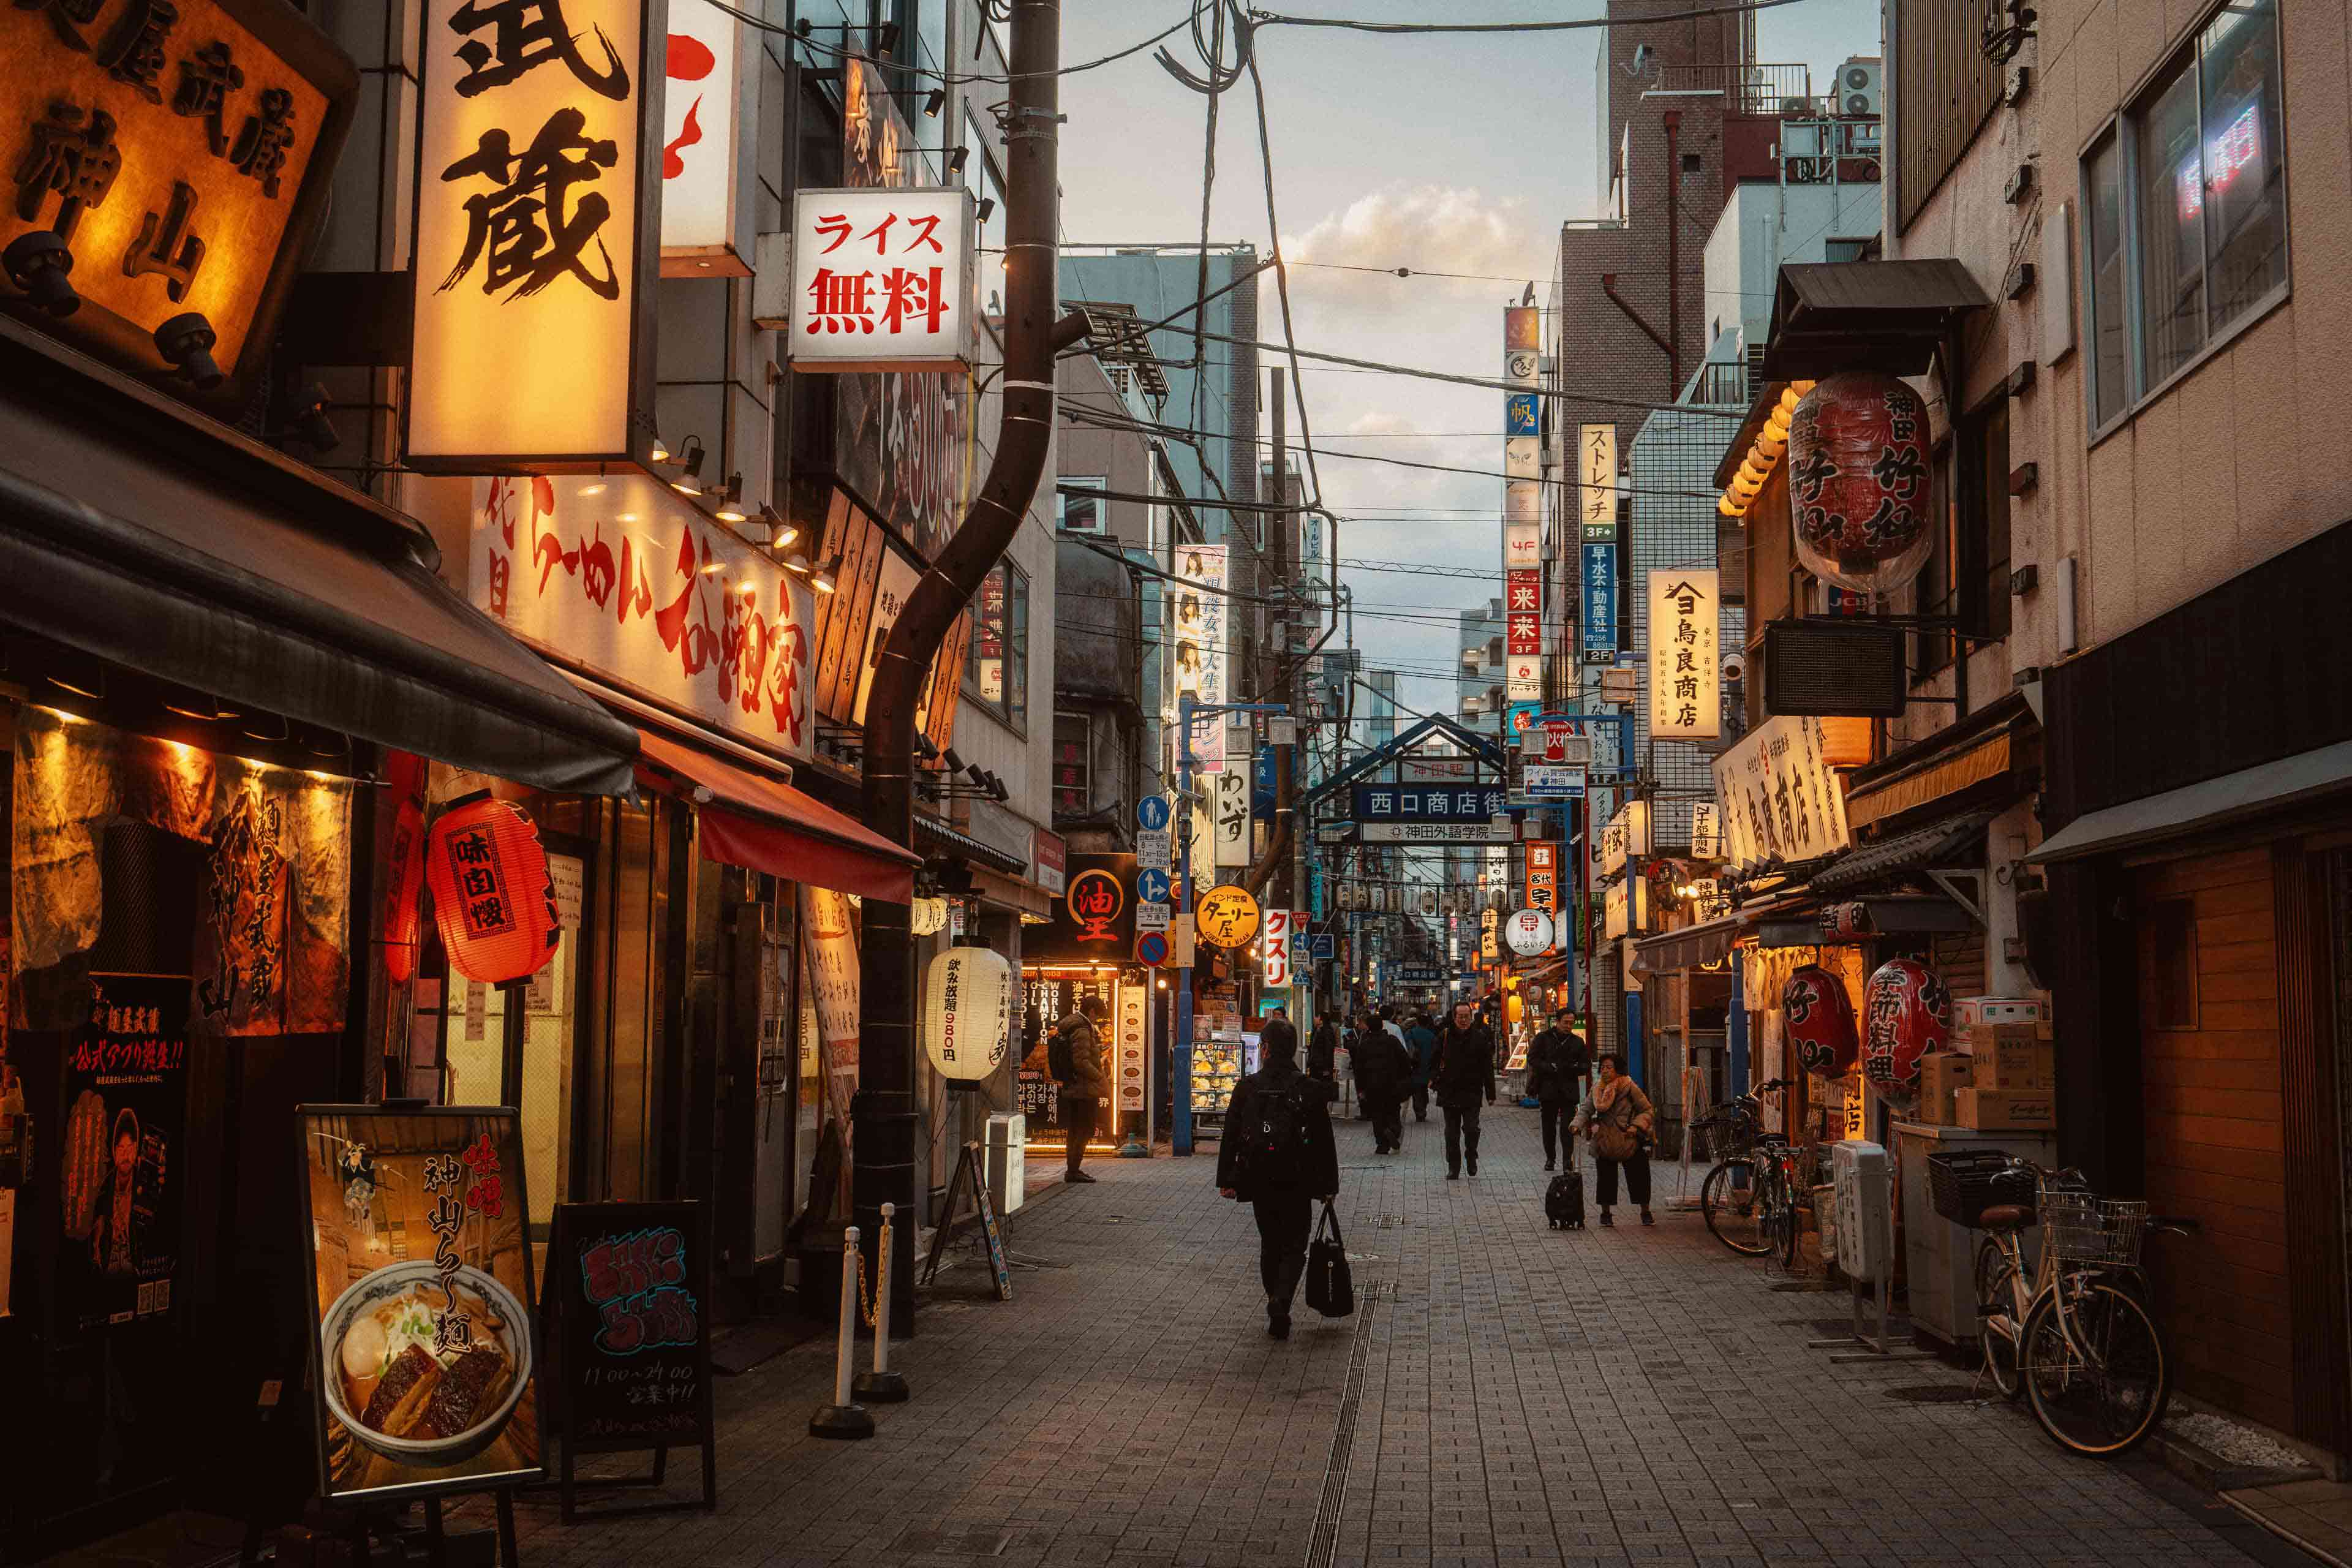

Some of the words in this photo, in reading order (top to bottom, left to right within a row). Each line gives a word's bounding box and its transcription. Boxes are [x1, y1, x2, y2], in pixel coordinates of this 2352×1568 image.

[813, 211, 944, 255] ライス
[806, 266, 950, 334] 無料
[1589, 429, 1608, 519] ストレッチ
[1586, 527, 1603, 537] 3F
[1512, 541, 1534, 551] 4F
[1591, 546, 1607, 633] 早水不動産社
[1703, 627, 1711, 647] 東京
[1516, 645, 1533, 654] 3F
[1591, 651, 1610, 660] 2F
[1674, 619, 1700, 727] 鳥良商店
[1413, 764, 1464, 778] 神田駅
[1550, 777, 1566, 786] 神田
[1219, 769, 1248, 843] わいず
[1371, 791, 1507, 815] 西口商店街
[1405, 824, 1490, 839] 神田外語学院
[1212, 894, 1248, 903] インド定食
[1203, 902, 1256, 921] ターリー
[1205, 931, 1224, 944] CURRY
[1235, 932, 1251, 945] NAAN
[1219, 920, 1233, 937] 屋
[1267, 911, 1287, 985] クスリ
[943, 958, 962, 1063] 飲み放題980円
[1039, 981, 1049, 1045] CHAMPION
[1050, 981, 1060, 1022] WORLD
[1027, 1083, 1037, 1113] 맛있는
[1038, 1083, 1047, 1104] 가장
[1047, 1083, 1058, 1123] 세상에서
[462, 1132, 503, 1219] 味噌
